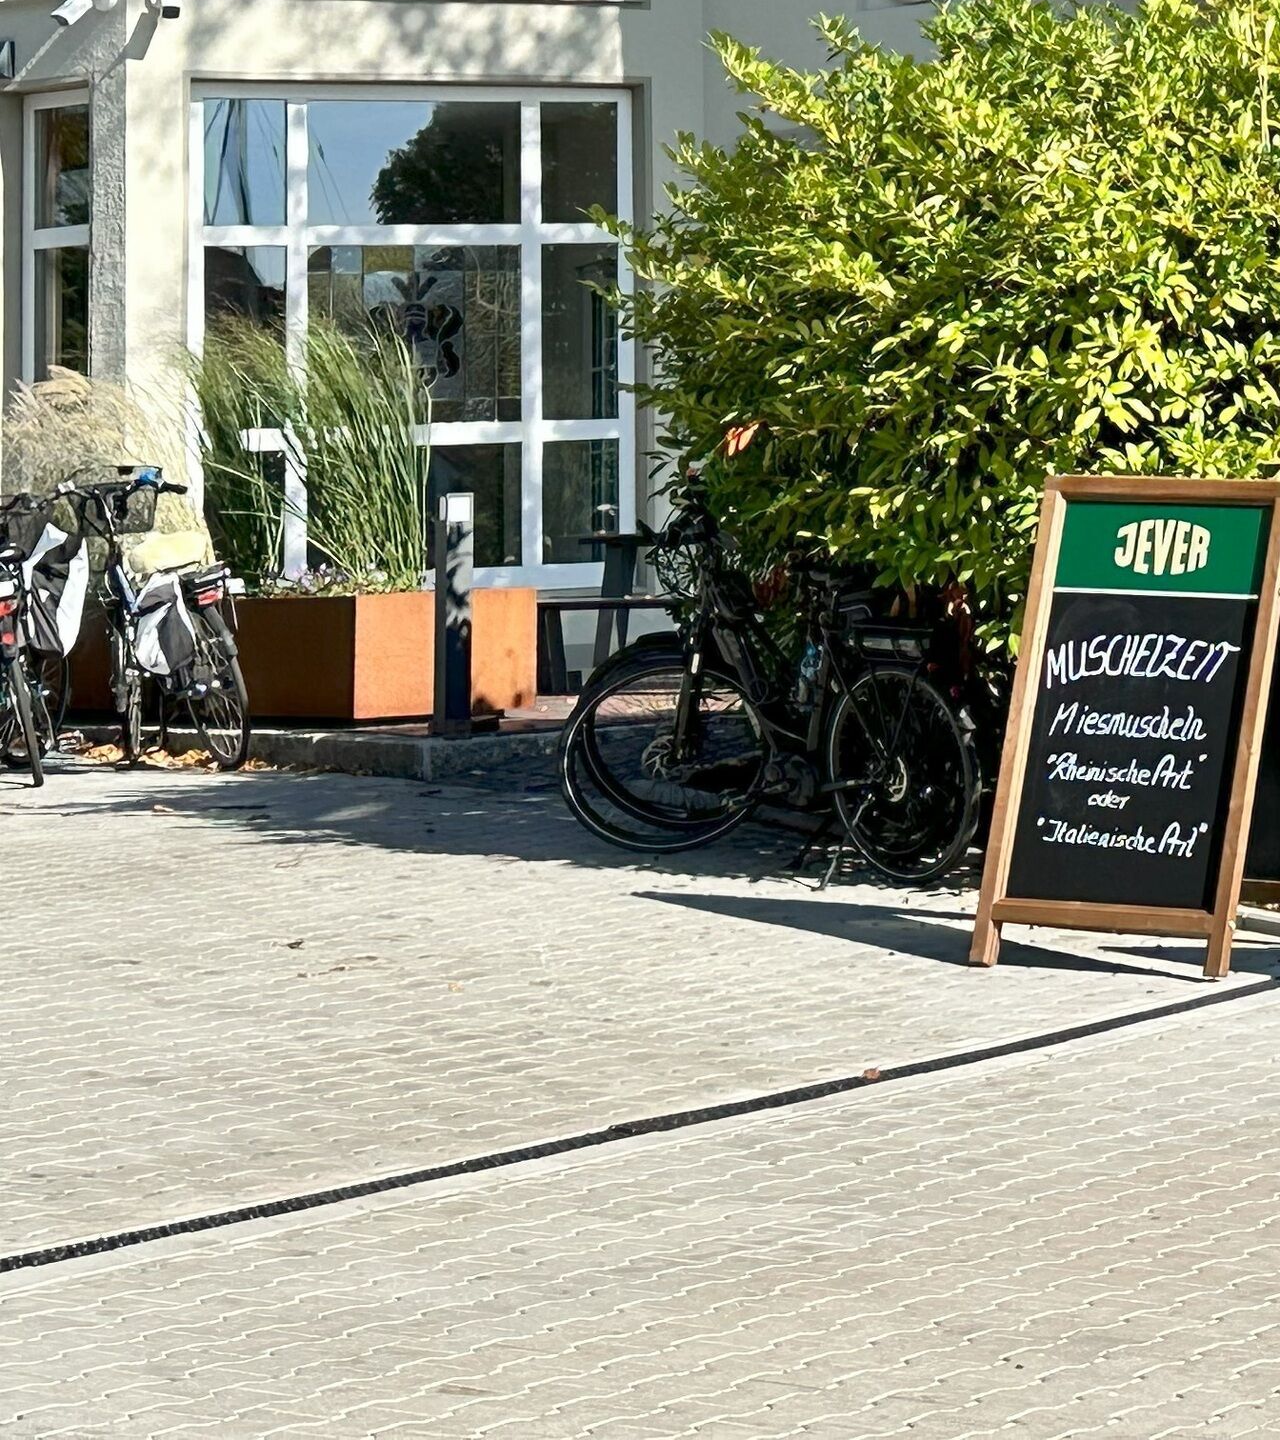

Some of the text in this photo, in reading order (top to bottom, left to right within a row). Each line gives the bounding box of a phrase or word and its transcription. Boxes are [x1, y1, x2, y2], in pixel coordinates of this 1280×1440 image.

[1113, 518, 1212, 576] JEVER
[1046, 632, 1242, 690] MUSCHELZEIT
[1048, 701, 1208, 742] Miesmuscheln
[1086, 788, 1131, 810] oder
